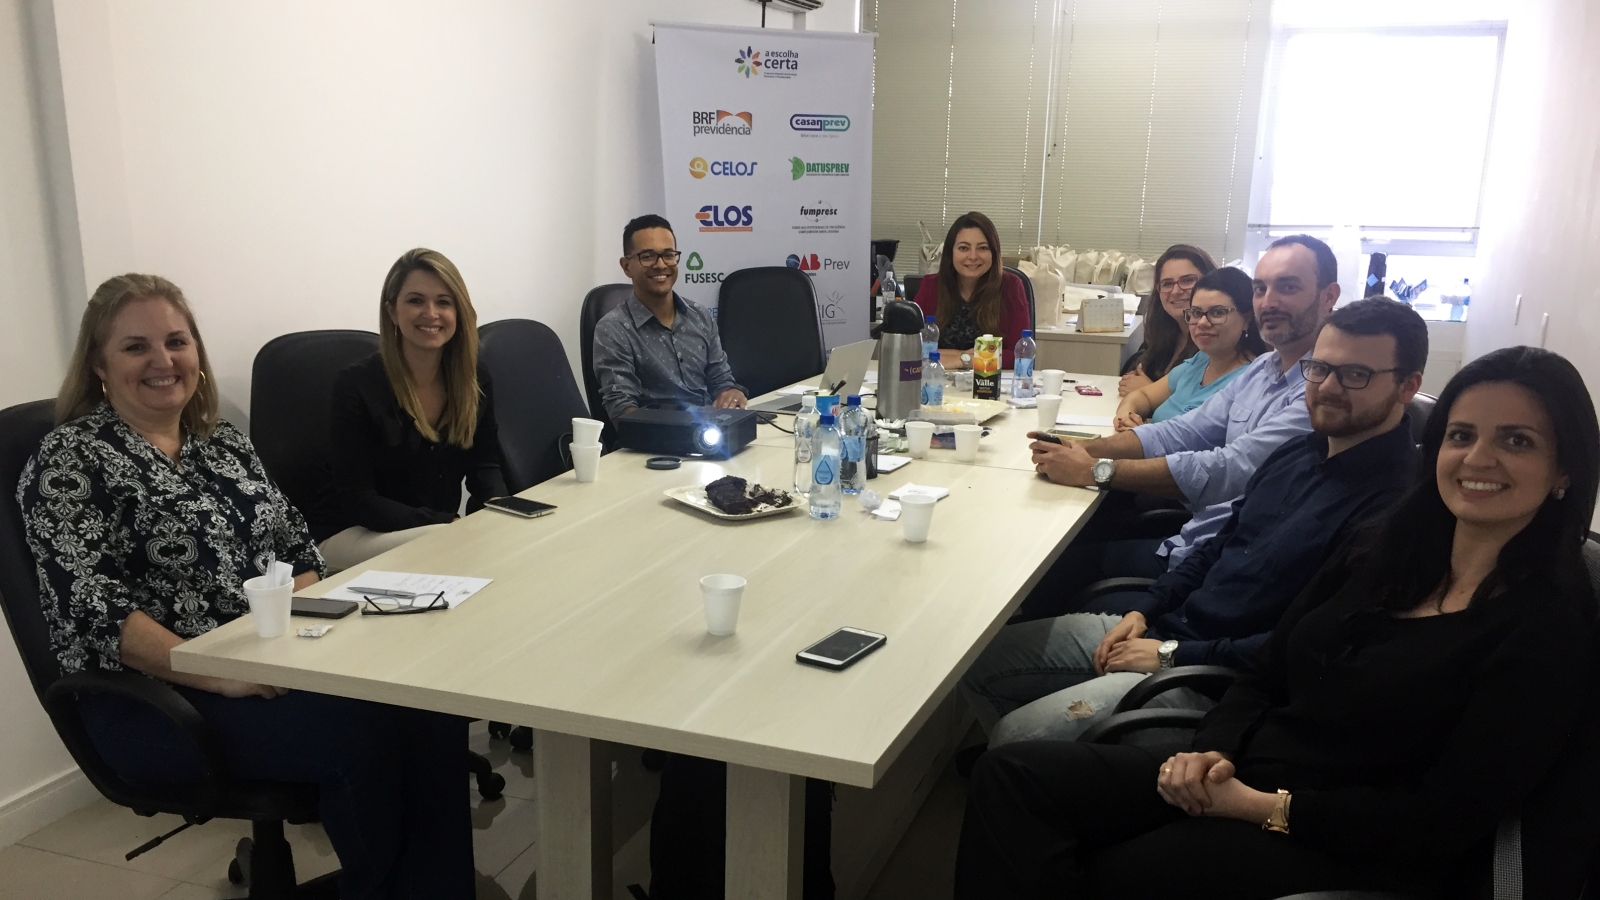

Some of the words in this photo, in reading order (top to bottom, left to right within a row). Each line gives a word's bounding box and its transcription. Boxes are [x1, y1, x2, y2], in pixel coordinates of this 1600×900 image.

[770, 50, 799, 58] escolha
[764, 58, 798, 70] certa
[693, 111, 716, 125] BRF
[693, 123, 752, 137] previdência
[710, 161, 758, 177] CELOS
[806, 162, 850, 173] DATUSPREV
[695, 205, 753, 227] ELOS
[800, 205, 838, 218] fumpresc
[824, 258, 851, 271] Prev
[685, 272, 725, 284] FUSESC
